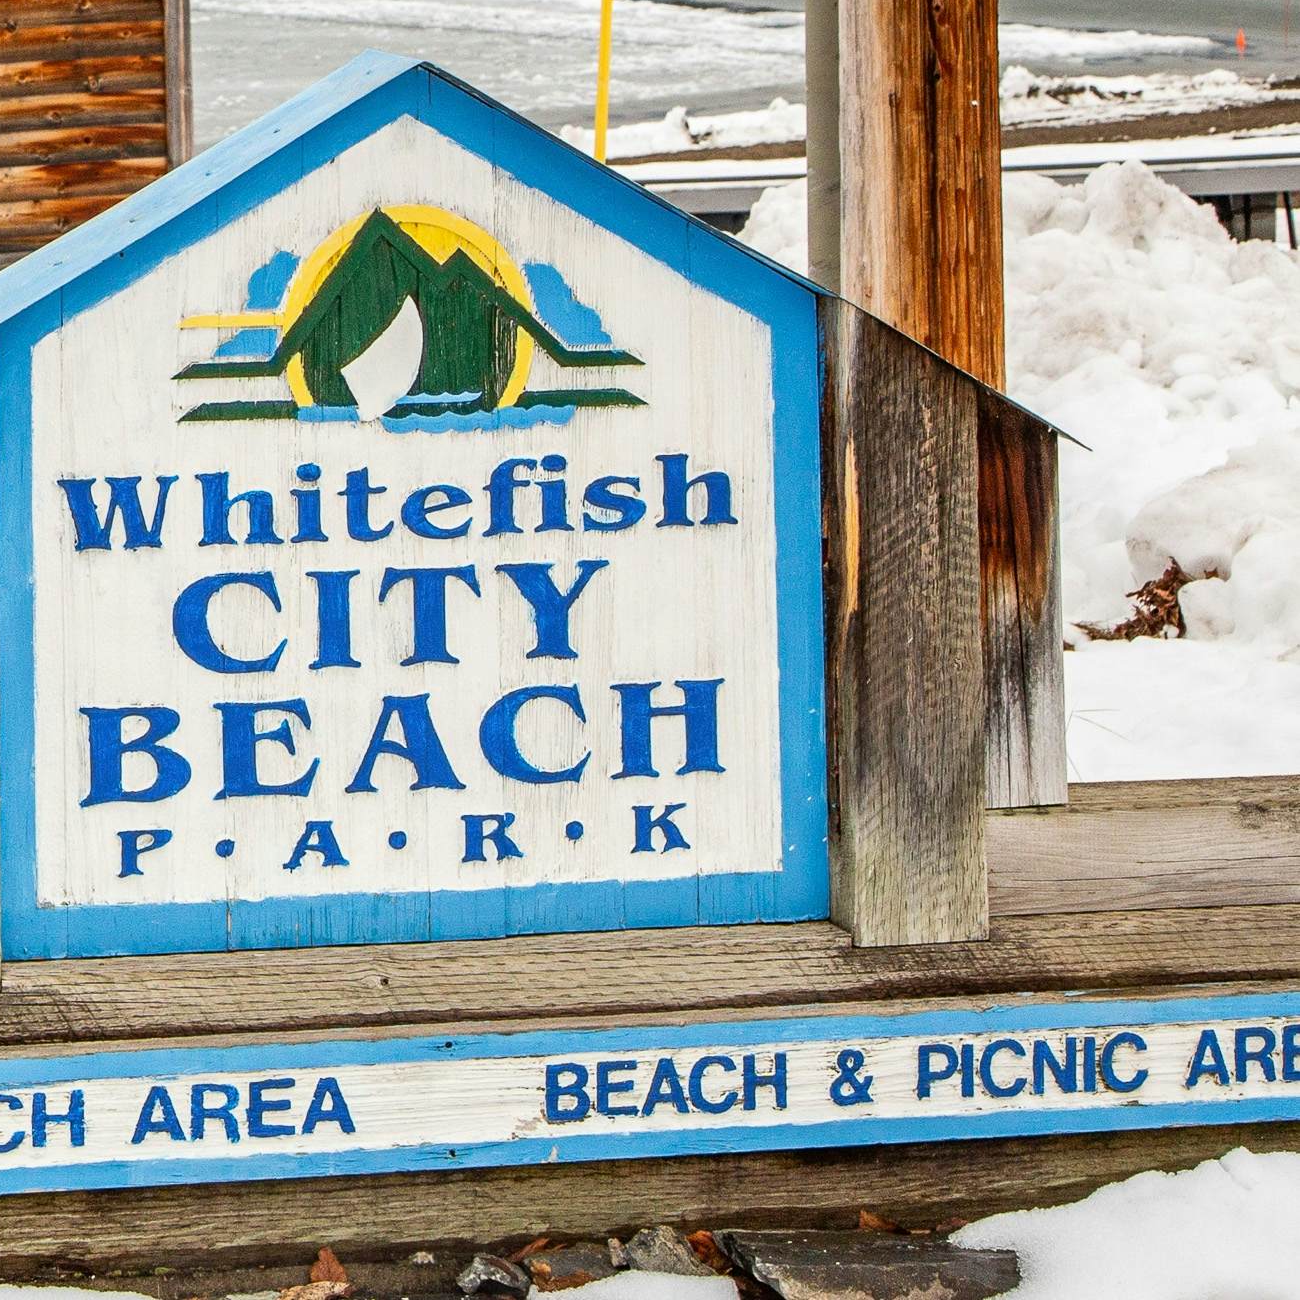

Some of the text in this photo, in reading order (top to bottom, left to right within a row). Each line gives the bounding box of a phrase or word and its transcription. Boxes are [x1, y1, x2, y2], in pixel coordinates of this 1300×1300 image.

[57, 452, 739, 552] Whitefish
[171, 558, 611, 674] CITY
[78, 676, 728, 809] BEACH
[130, 1076, 357, 1146] AREA
[544, 1052, 789, 1123] BEACH
[828, 1047, 875, 1107] &
[916, 1030, 1150, 1100] PICNIC
